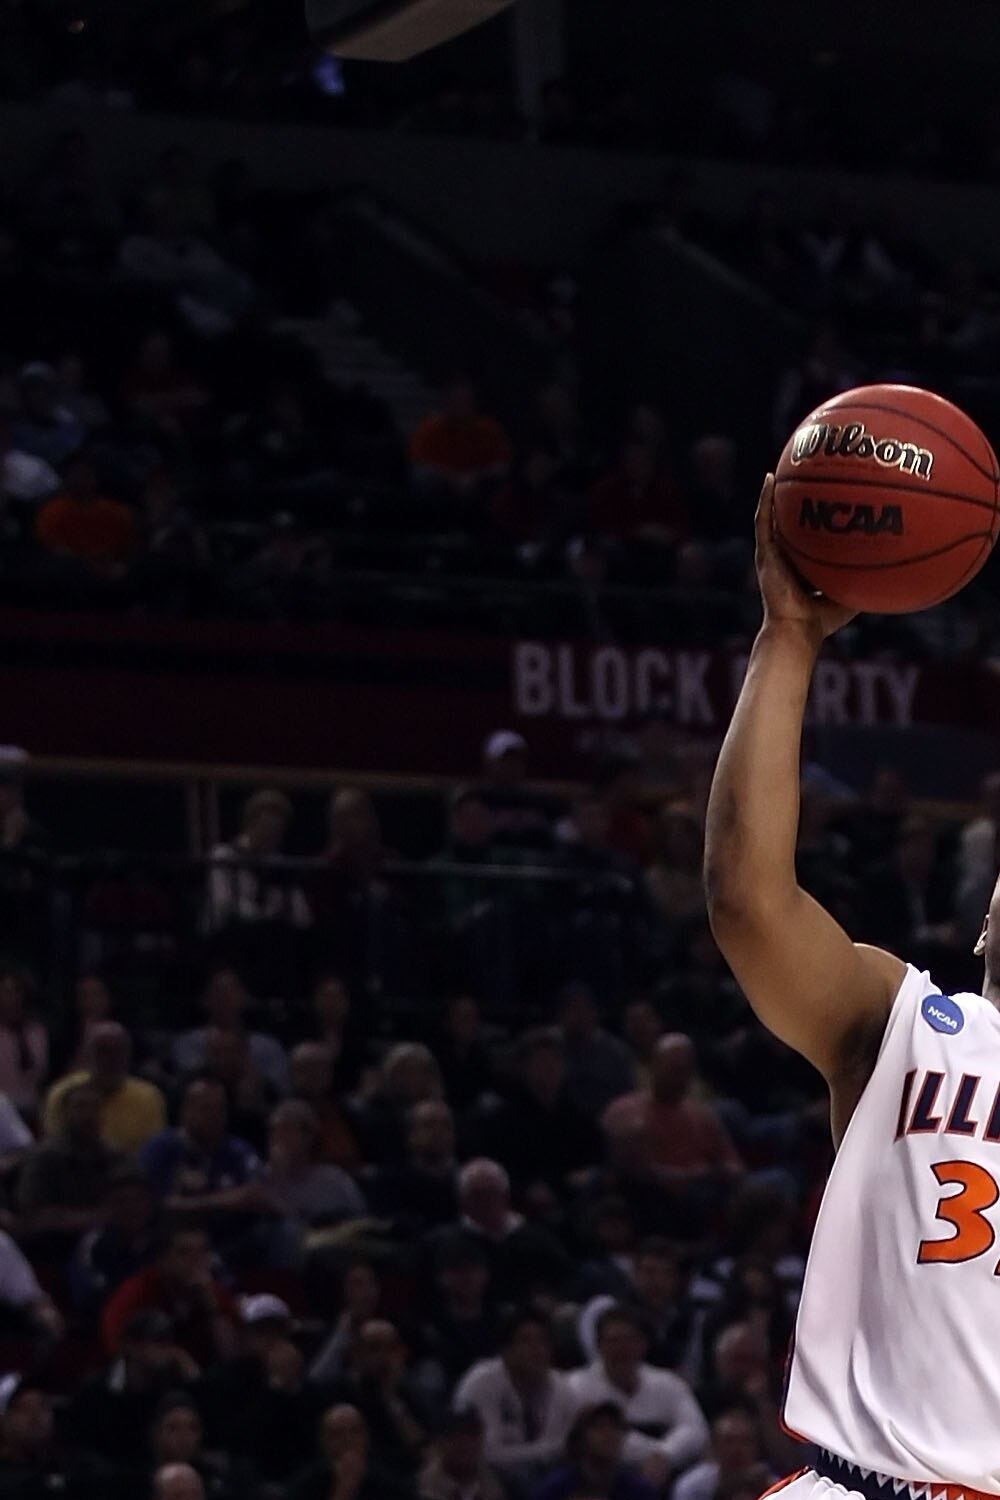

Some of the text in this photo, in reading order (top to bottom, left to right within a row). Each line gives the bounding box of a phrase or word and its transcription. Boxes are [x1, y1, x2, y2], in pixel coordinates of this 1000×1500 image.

[791, 422, 934, 481] Wilson
[799, 498, 904, 536] NCAA
[515, 645, 920, 728] BLOCK RTY
[927, 1005, 958, 1029] NCAA
